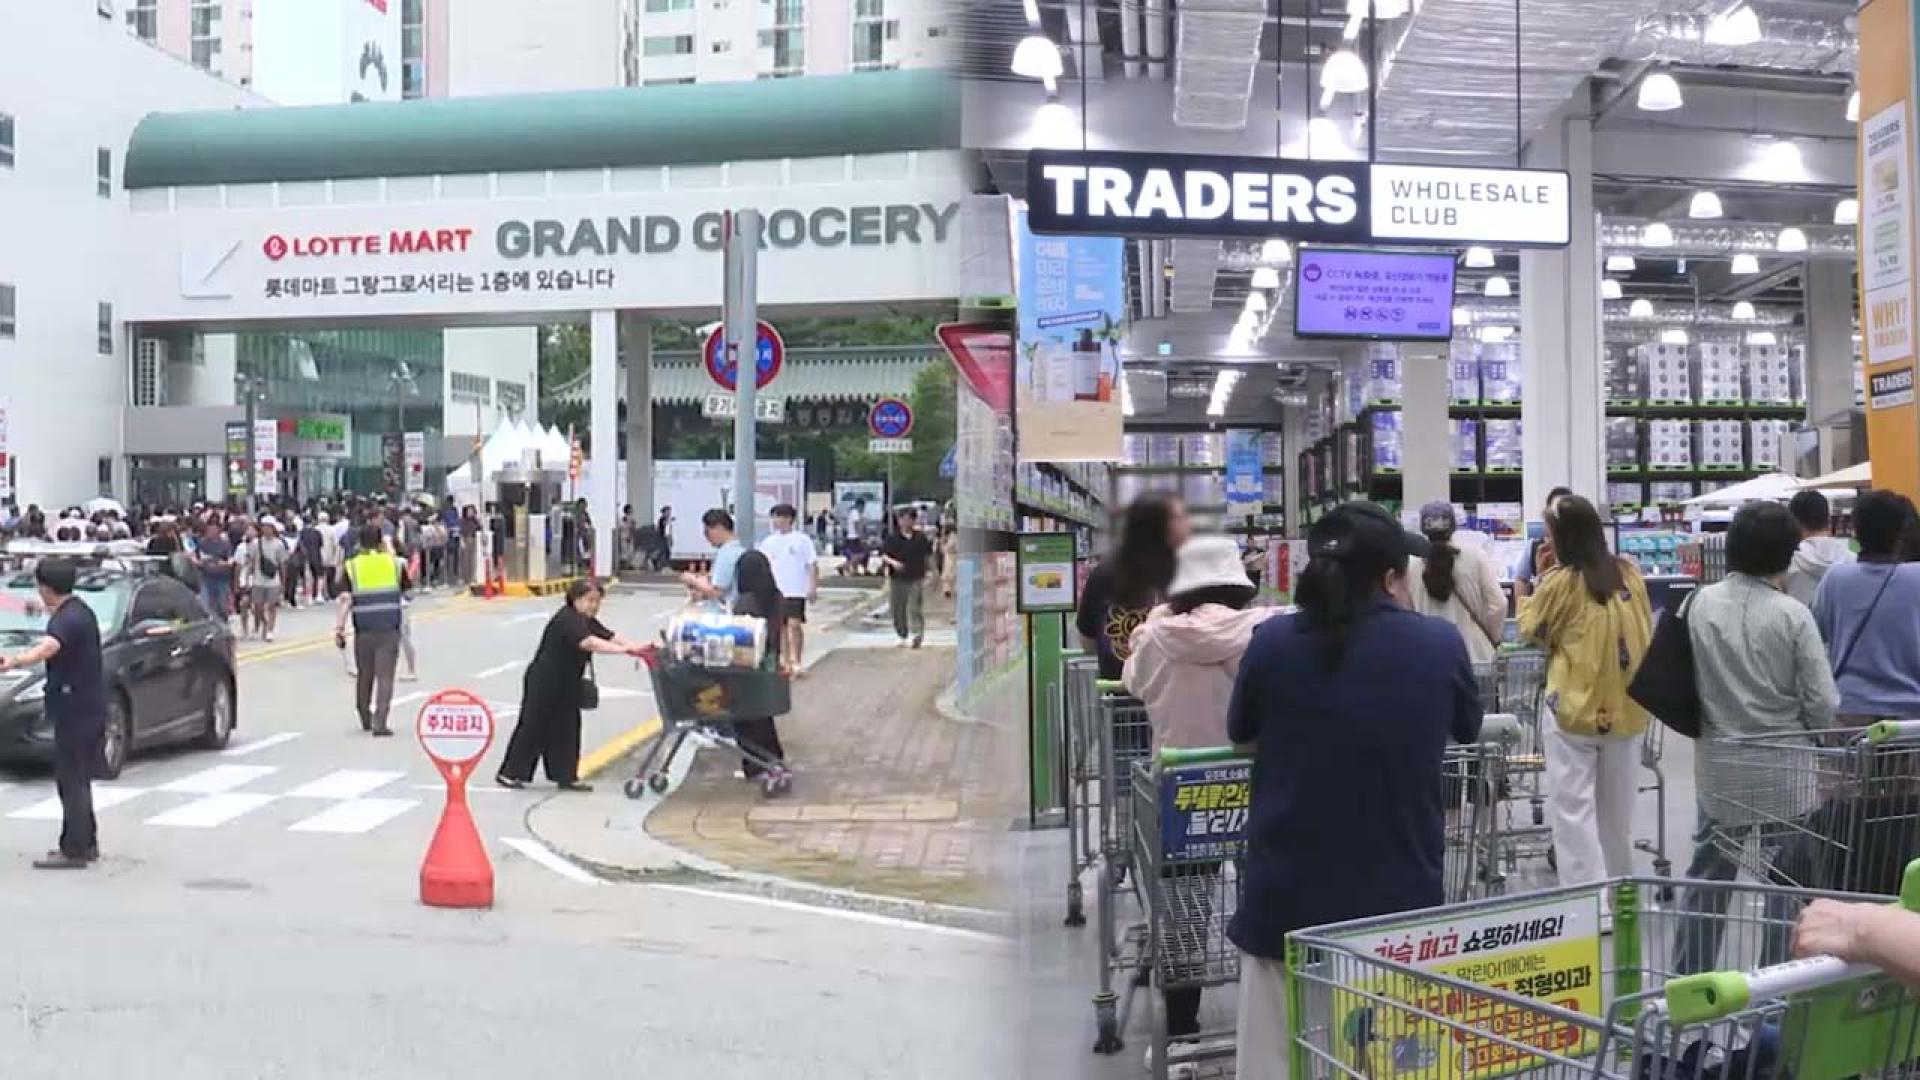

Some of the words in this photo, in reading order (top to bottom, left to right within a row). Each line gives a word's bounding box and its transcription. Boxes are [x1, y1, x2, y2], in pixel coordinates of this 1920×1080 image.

[1043, 164, 1356, 226] TRADERS
[1391, 179, 1551, 204] WHOLESALE
[1391, 206, 1458, 226] CLUB
[293, 235, 382, 257] LOTTE
[389, 229, 473, 254] MART
[495, 215, 681, 260] GRAND
[264, 275, 338, 298] 롯데마트
[342, 272, 475, 297] 그랑그로서리는
[480, 270, 531, 293] 1층에
[536, 268, 616, 291] 있습니다
[427, 713, 484, 733] 주차금지
[1417, 930, 1460, 962] 펴고
[1462, 915, 1565, 954] 쇼핑하세요!
[1514, 965, 1592, 998] 정형외과
